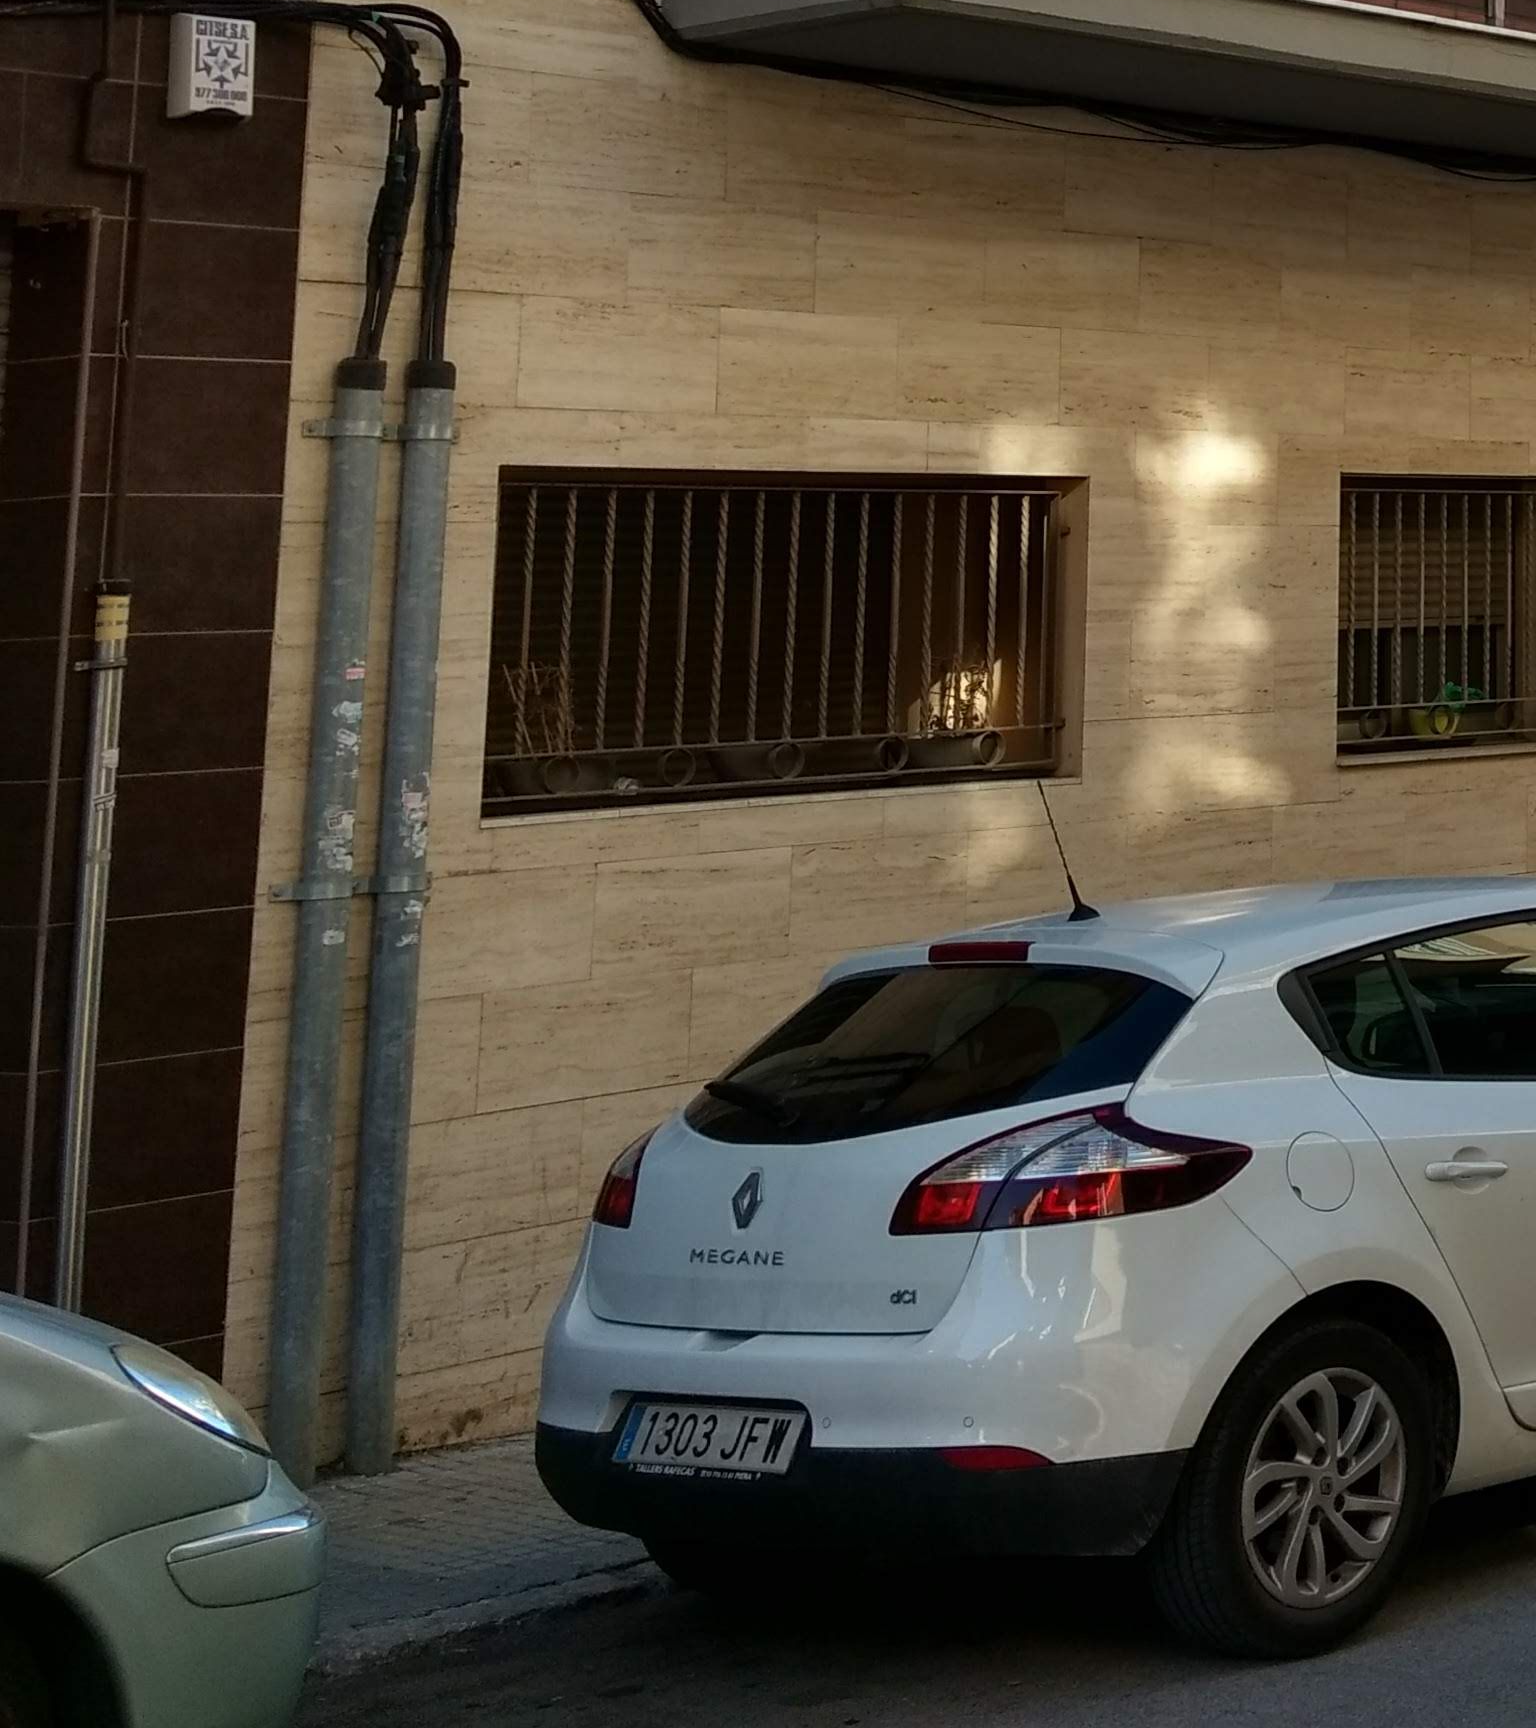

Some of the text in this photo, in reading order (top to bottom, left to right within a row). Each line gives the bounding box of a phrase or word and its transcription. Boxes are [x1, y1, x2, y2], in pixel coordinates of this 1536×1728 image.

[689, 1248, 784, 1266] MEGANE
[640, 1411, 718, 1458] 1303
[720, 1415, 792, 1464] JFW
